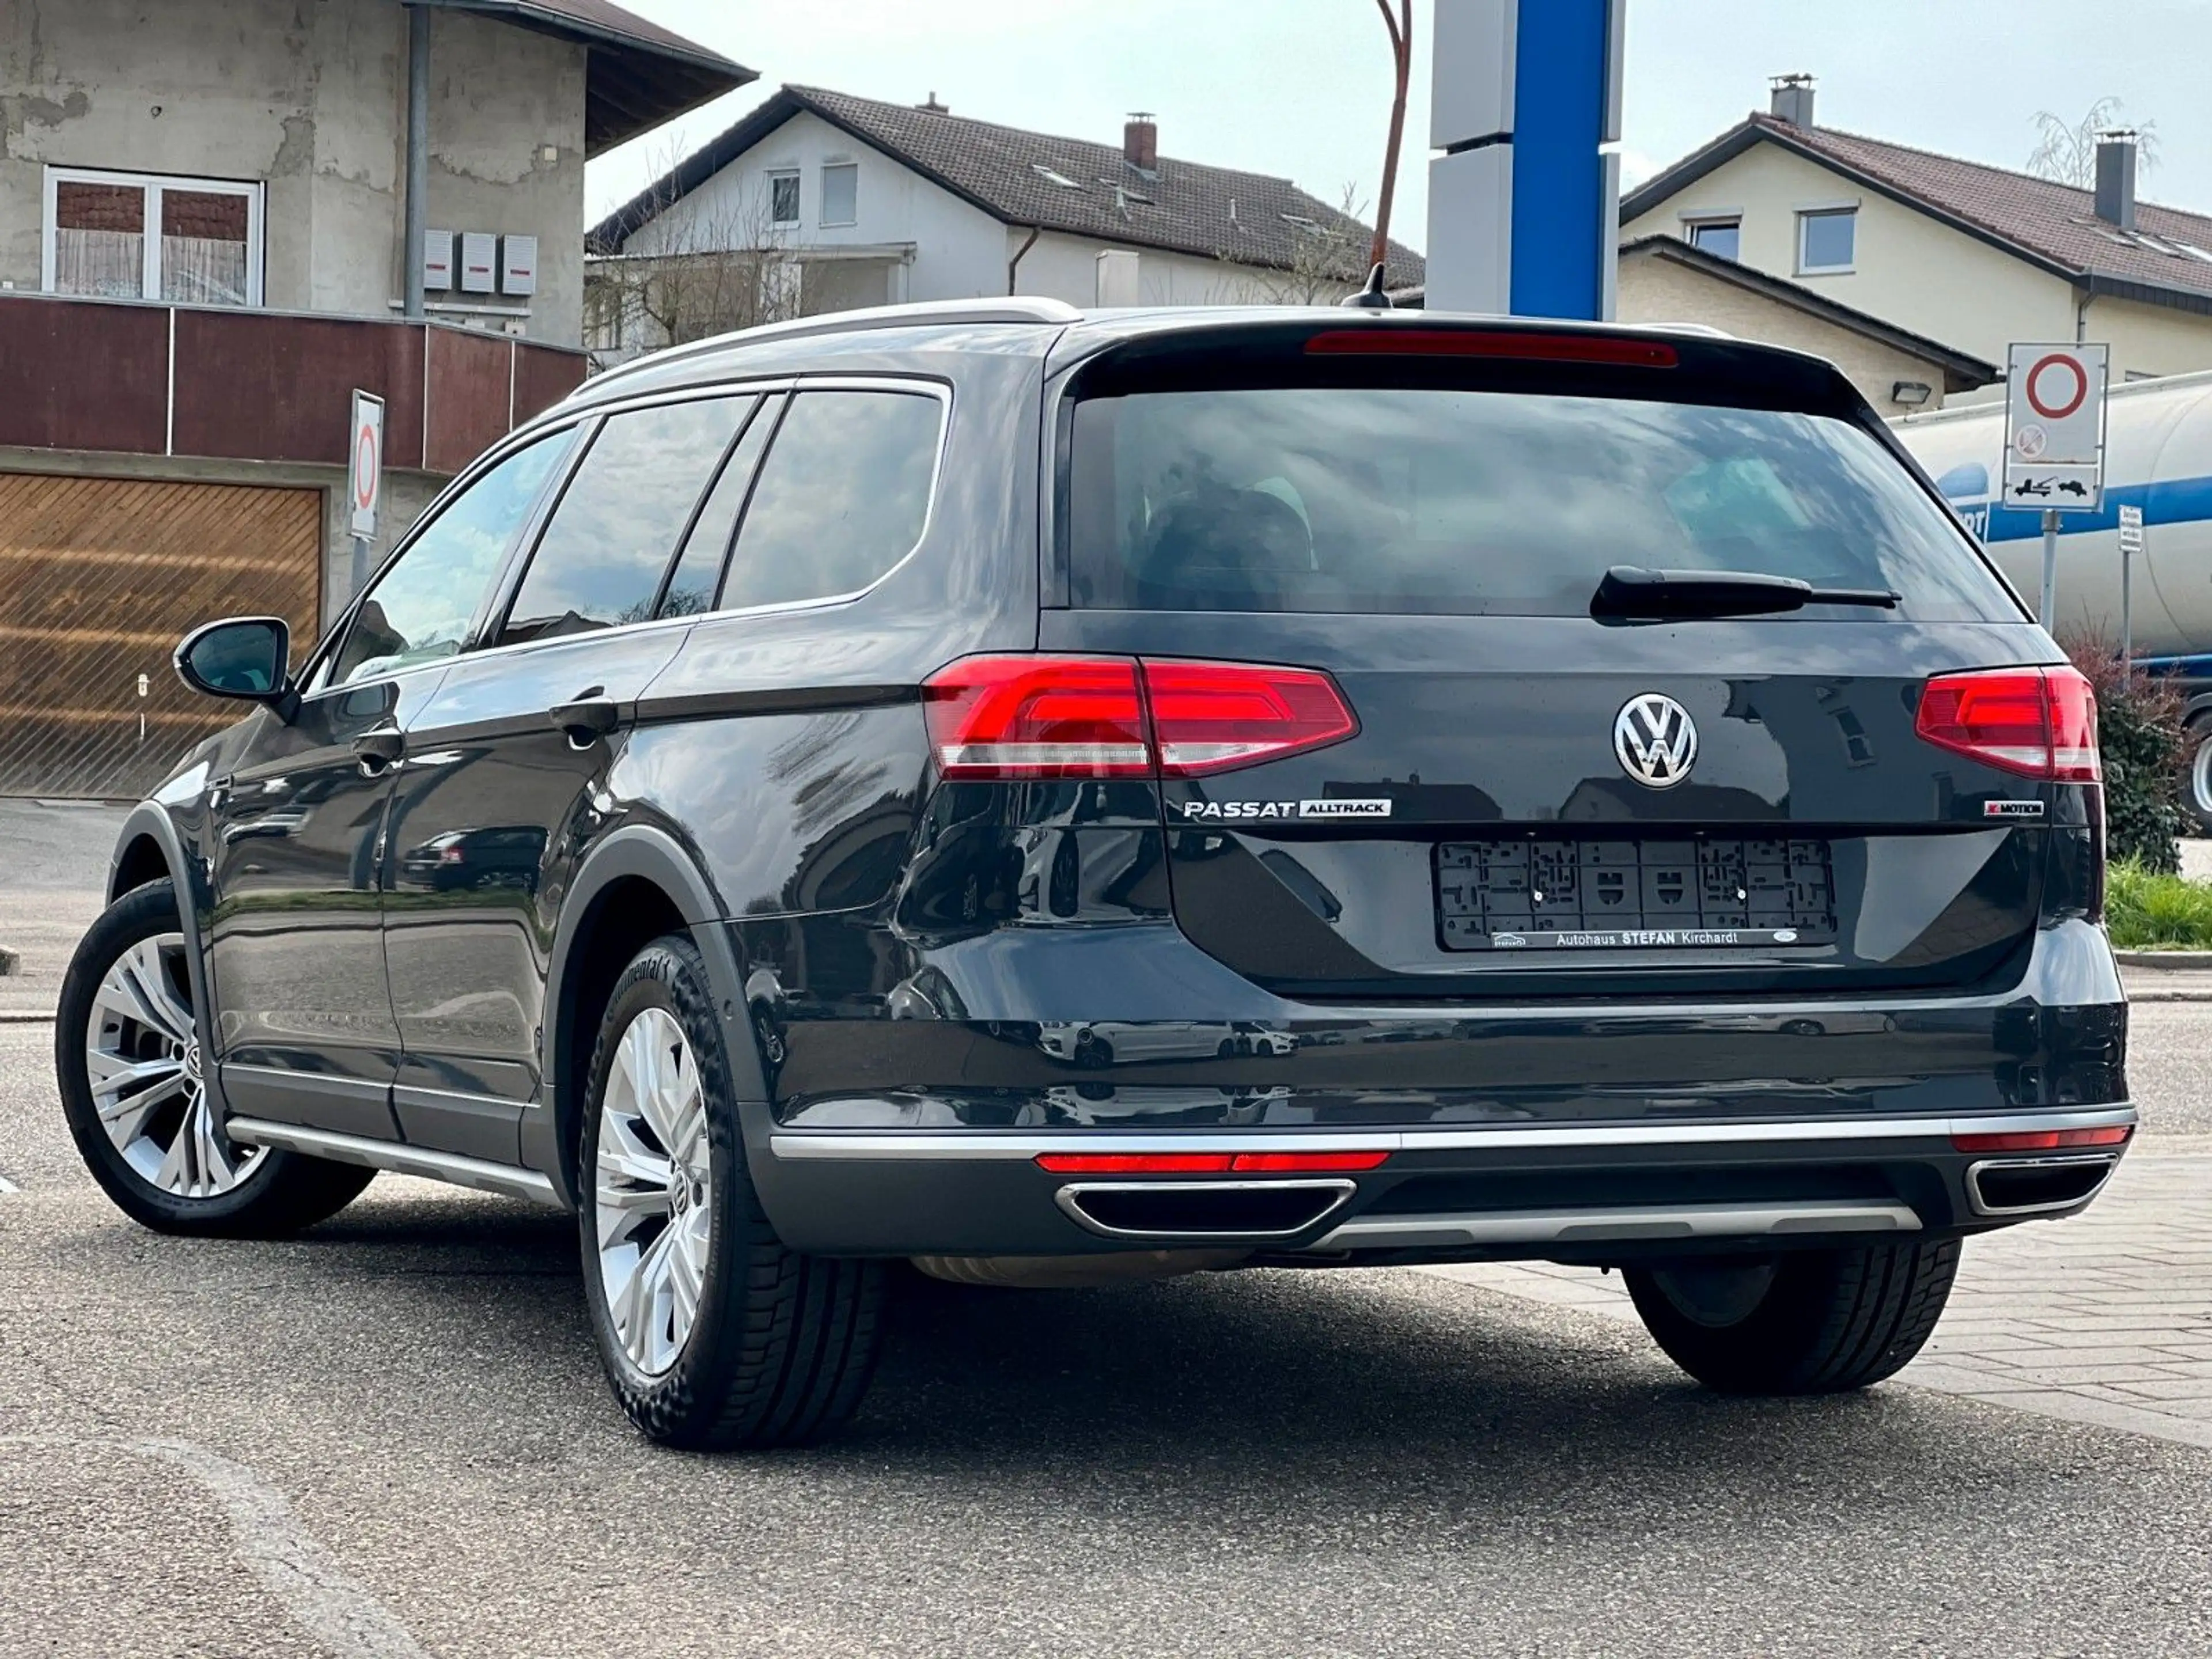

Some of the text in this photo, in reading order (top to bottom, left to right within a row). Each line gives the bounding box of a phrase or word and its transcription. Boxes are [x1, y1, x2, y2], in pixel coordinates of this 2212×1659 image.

[1183, 801, 1384, 817] PASSAT ALLTRACK
[1556, 931, 1738, 946] Autohaus STEFAN Kirchardt
